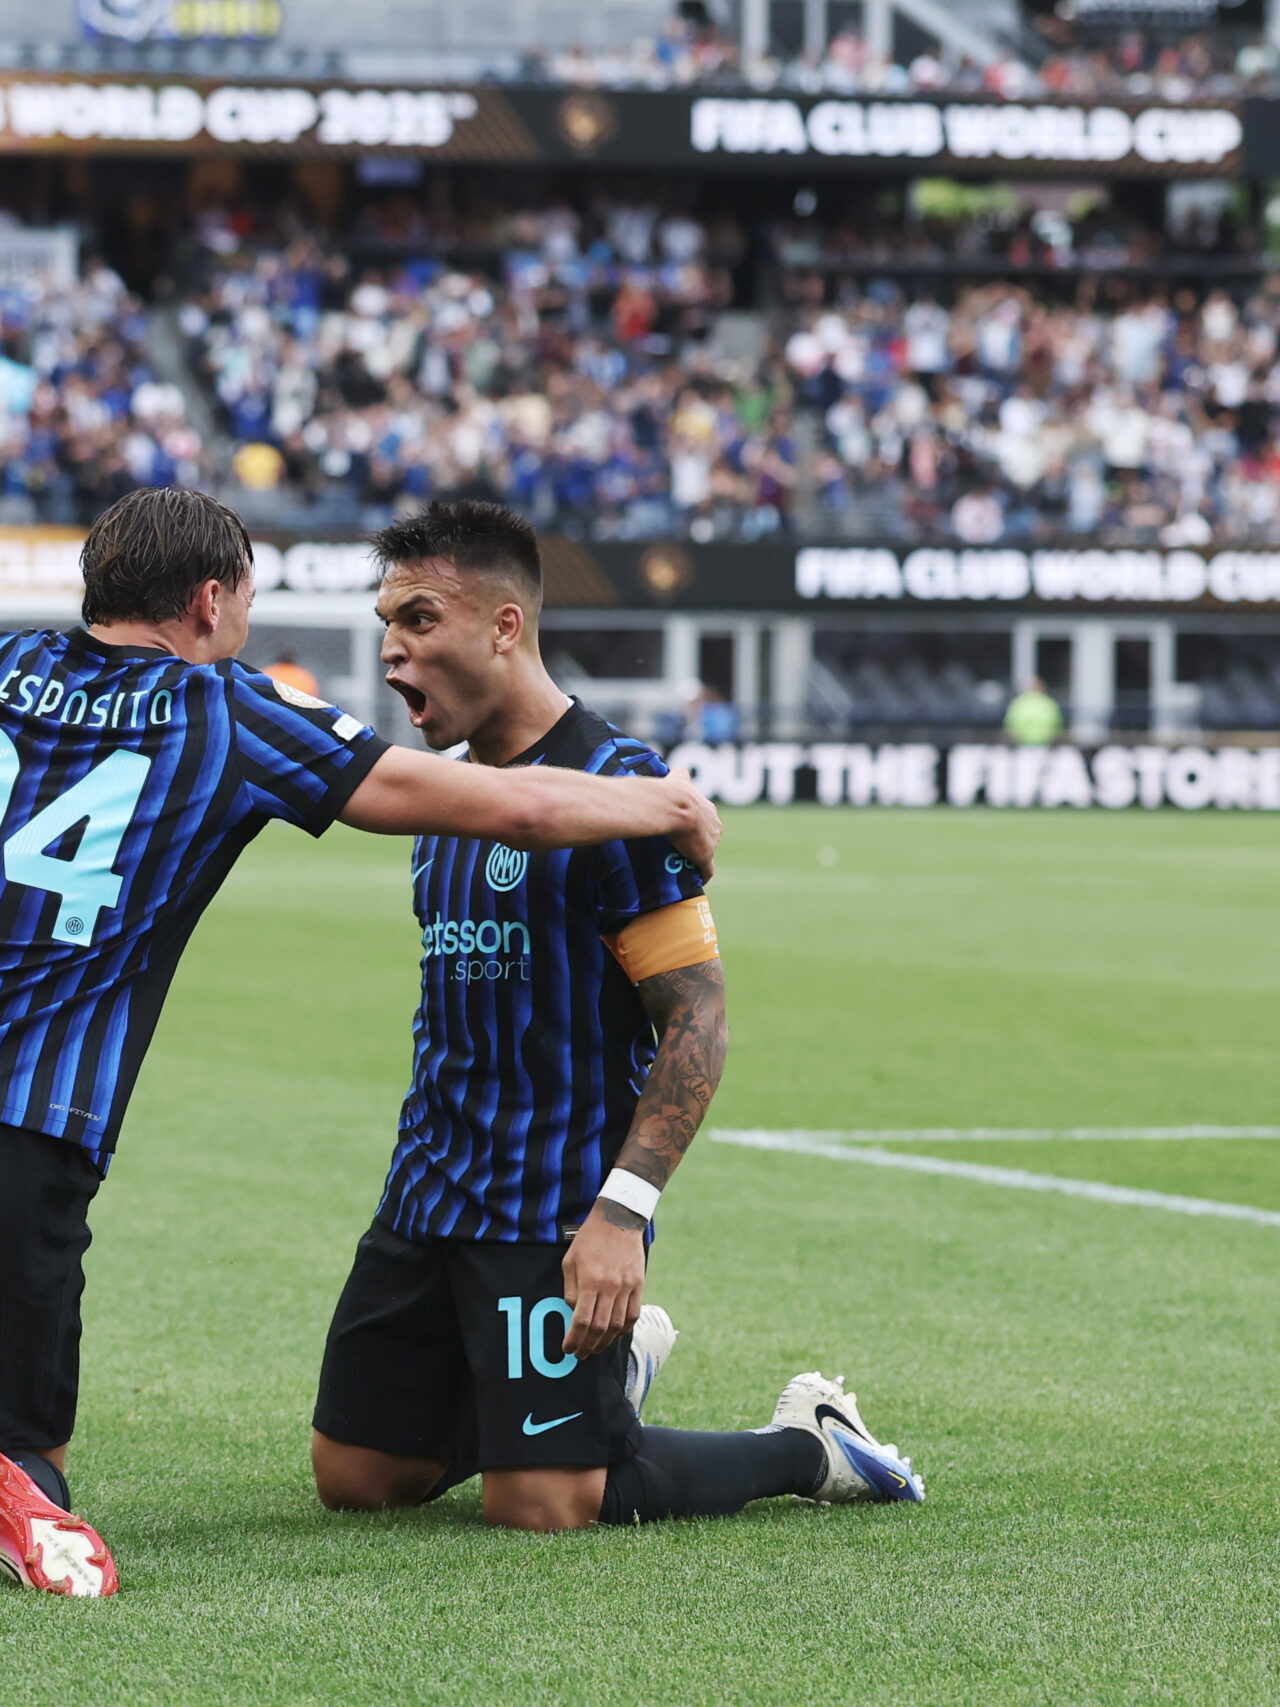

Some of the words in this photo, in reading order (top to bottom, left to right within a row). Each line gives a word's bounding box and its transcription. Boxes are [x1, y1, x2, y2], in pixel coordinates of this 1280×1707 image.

[8, 84, 203, 142] WORLD
[205, 86, 318, 143] CUP
[690, 98, 808, 154] FIFA
[808, 101, 943, 158] CLUB
[944, 104, 1132, 162] WORLD
[1133, 108, 1242, 164] CUP
[795, 547, 903, 600] FIFA
[903, 548, 1030, 601] CLUB
[1031, 549, 1207, 601] WORLD
[1208, 550, 1280, 602] CU
[812, 743, 938, 807] THE
[421, 911, 531, 956] etsson
[450, 956, 530, 986] .sport
[498, 1296, 580, 1379] 10
